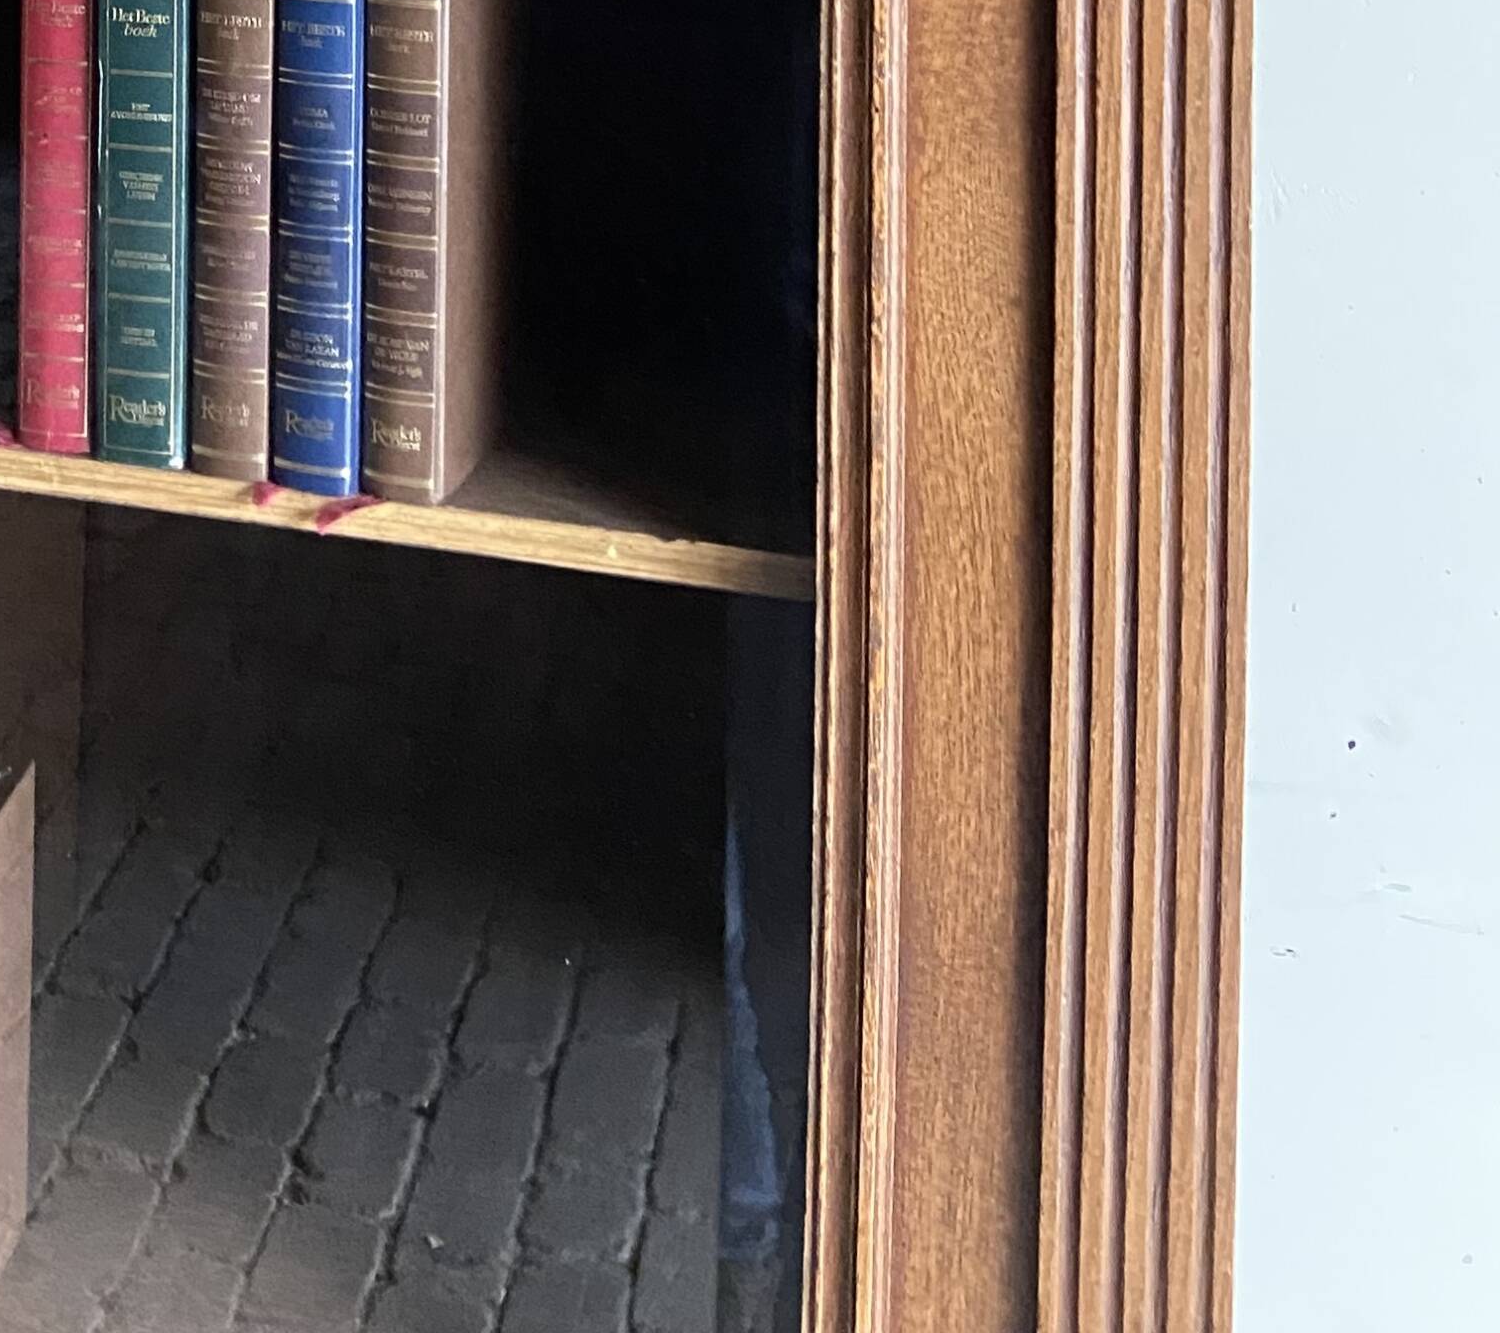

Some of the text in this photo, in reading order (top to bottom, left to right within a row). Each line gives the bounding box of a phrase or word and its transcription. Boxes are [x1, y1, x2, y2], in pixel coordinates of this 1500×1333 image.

[112, 7, 171, 25] Het Beste
[124, 24, 158, 38] boek
[410, 113, 432, 125] LOT
[406, 339, 430, 354] VAN
[108, 394, 166, 421] Reader's
